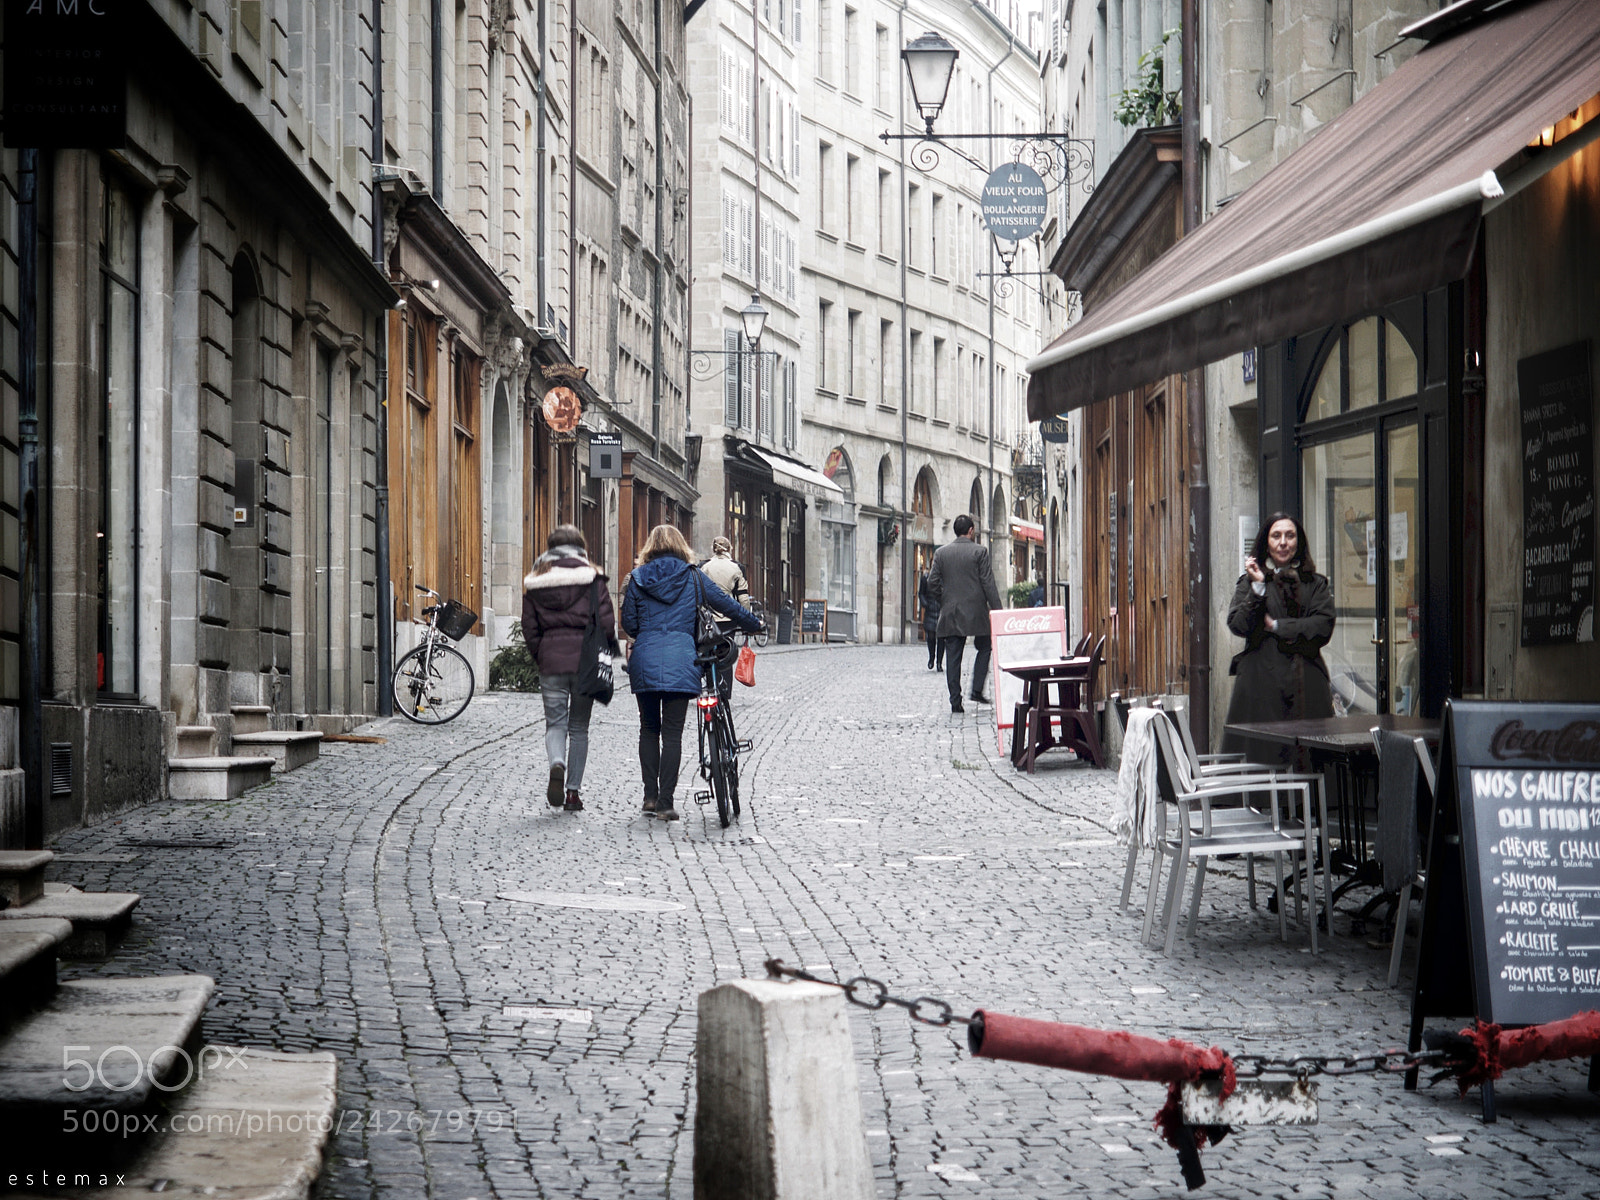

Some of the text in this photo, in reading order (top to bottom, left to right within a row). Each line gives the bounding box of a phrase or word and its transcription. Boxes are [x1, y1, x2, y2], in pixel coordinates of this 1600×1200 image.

[1008, 173, 1023, 183] AU
[985, 186, 1044, 196] VIEUX FOUR
[983, 205, 1046, 214] BOULANGERIE
[990, 217, 1038, 226] PATISSERIE
[1546, 451, 1580, 473] BOMBAY
[1547, 473, 1571, 493] TONIC
[1004, 615, 1052, 633] Coca-Cola
[1474, 771, 1517, 798] NOS
[1498, 807, 1533, 829] DU
[1539, 807, 1589, 831] MIDI
[1499, 836, 1551, 858] CHÈVRE
[1502, 872, 1556, 891] SAUMON
[1503, 901, 1537, 916] LARD
[1506, 931, 1559, 951] RACLETTE
[1505, 965, 1556, 983] TOMATE
[1557, 966, 1570, 982] &
